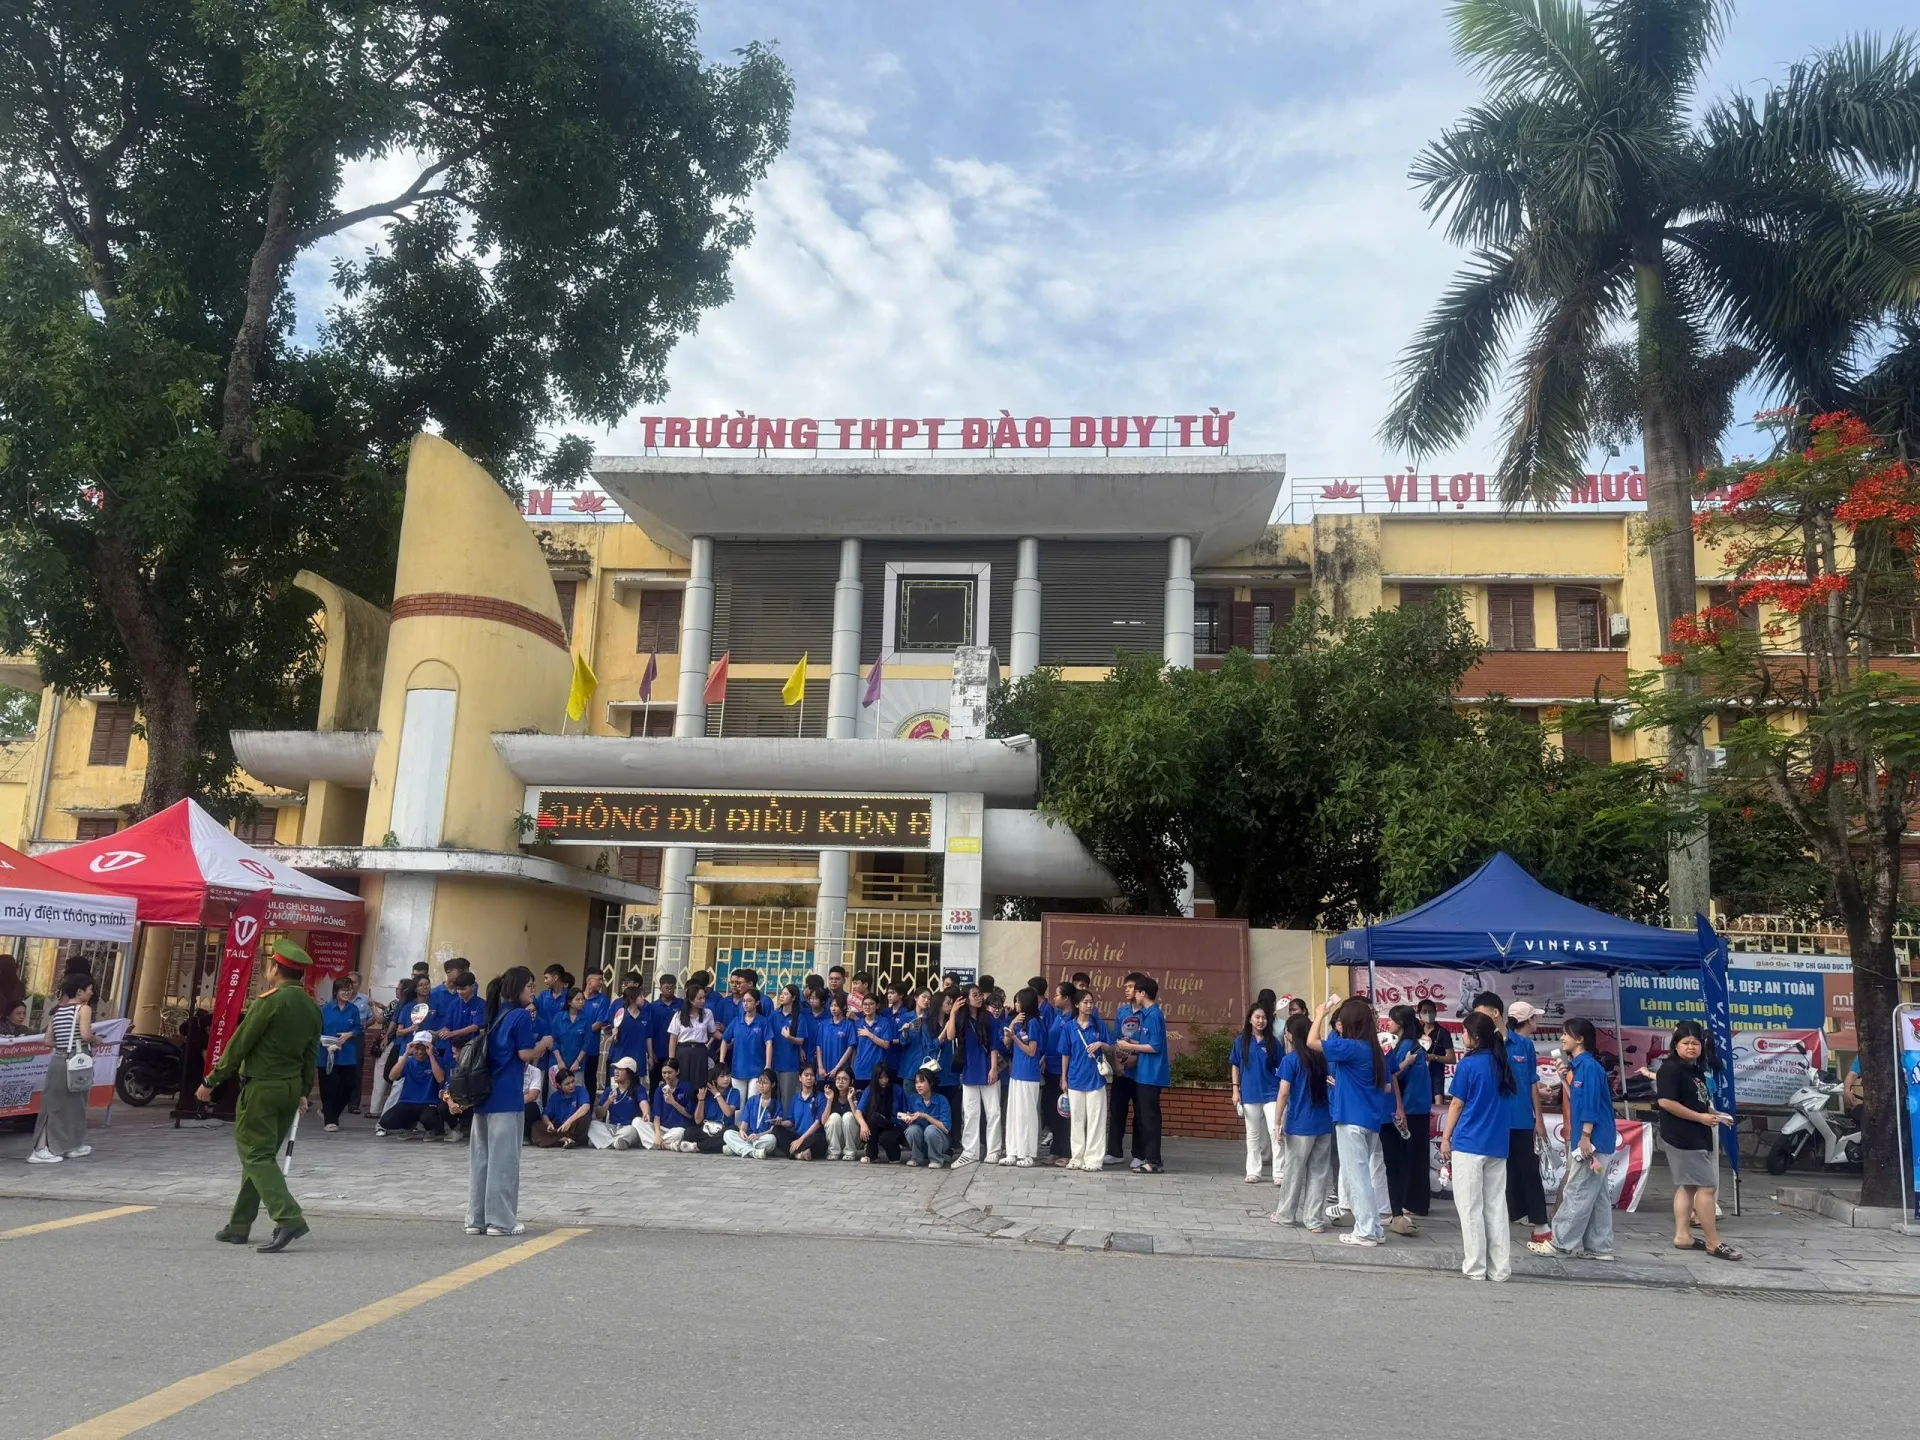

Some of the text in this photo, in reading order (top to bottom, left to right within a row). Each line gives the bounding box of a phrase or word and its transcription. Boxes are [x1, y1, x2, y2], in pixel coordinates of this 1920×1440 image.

[640, 407, 1235, 449] TRƯỜNG THPT ĐÀO DUY TỪ
[1384, 466, 1418, 502] VÌ
[1430, 472, 1486, 509] LỢI
[541, 797, 659, 831] HÔNG
[4, 903, 126, 926] máy điện thông minh
[286, 901, 309, 911] CHÚC
[950, 911, 973, 923] 33
[225, 949, 251, 958] TAIL
[1524, 940, 1609, 951] VINFAST
[229, 968, 240, 986] 168
[1164, 970, 1204, 996] luyện
[1619, 973, 1649, 988] CỔNG
[1651, 976, 1699, 990] TRƯỜNG
[1739, 980, 1763, 995] ĐẸP,
[1765, 982, 1780, 993] AN
[1783, 981, 1814, 995] TOÀN
[1404, 979, 1446, 1001] TỐC
[1640, 998, 1672, 1011] Làm
[1676, 998, 1705, 1012] chủ
[1752, 1004, 1793, 1019] nghệ
